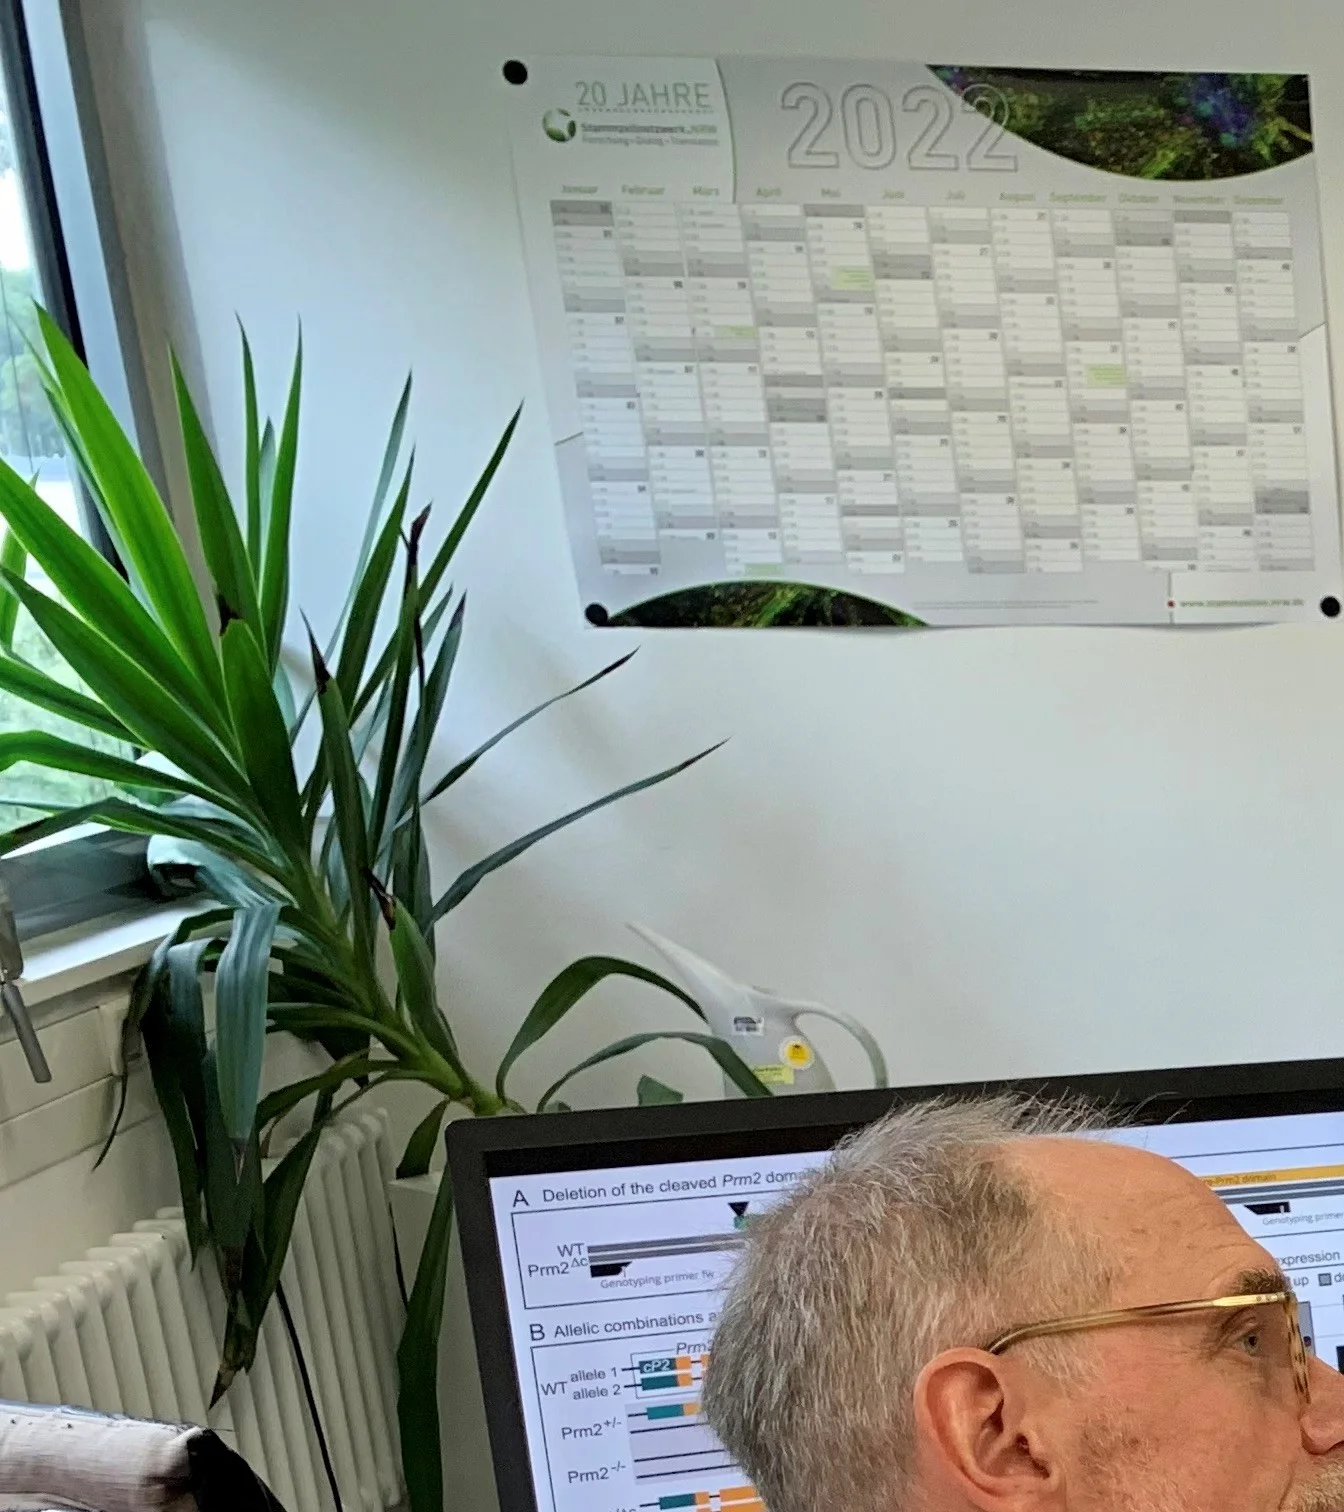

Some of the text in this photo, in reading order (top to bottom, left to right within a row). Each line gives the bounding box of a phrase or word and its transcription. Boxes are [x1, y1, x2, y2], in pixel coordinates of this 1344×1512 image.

[575, 81, 711, 108] 20 JAHRE
[780, 82, 1018, 172] 2022
[512, 1171, 798, 1208] A Deletion of the cleaved Prm2 dom
[1262, 1215, 1314, 1226] Genotyping
[1315, 1212, 1343, 1223] primer
[557, 1243, 585, 1257] WT
[600, 1275, 661, 1289] Genotyping
[664, 1271, 698, 1283] primer
[1293, 1276, 1309, 1287] up
[530, 1324, 545, 1341] B
[554, 1322, 600, 1338] Allelic
[604, 1313, 704, 1333] combinations
[643, 1358, 670, 1373] cP2
[570, 1367, 618, 1383] allele 1
[541, 1382, 568, 1396] WT
[573, 1384, 621, 1400] allele 2
